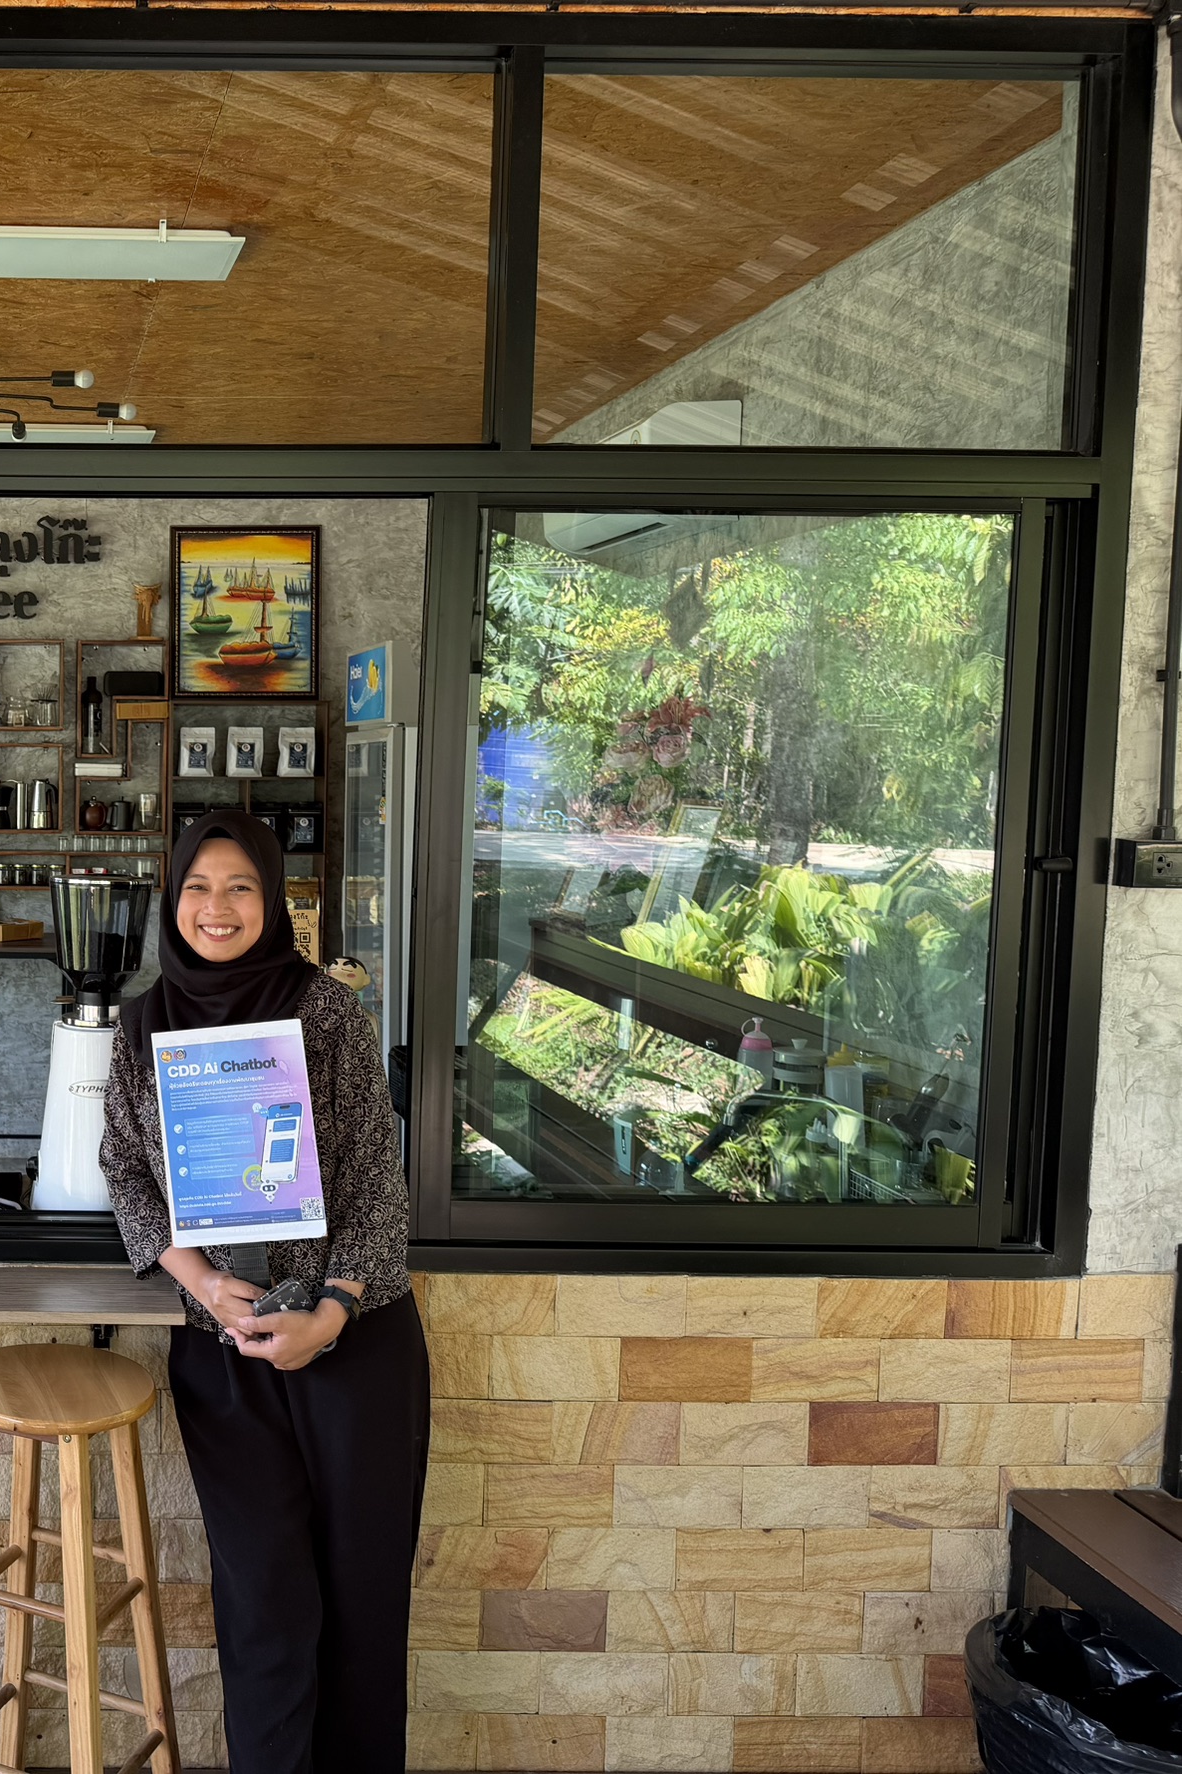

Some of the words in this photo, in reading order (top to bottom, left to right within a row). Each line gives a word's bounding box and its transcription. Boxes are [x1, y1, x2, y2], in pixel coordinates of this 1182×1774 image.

[350, 664, 363, 680] Haier
[167, 1064, 201, 1078] CDD
[220, 1057, 277, 1073] Chatbot
[75, 1085, 105, 1093] TYPH
